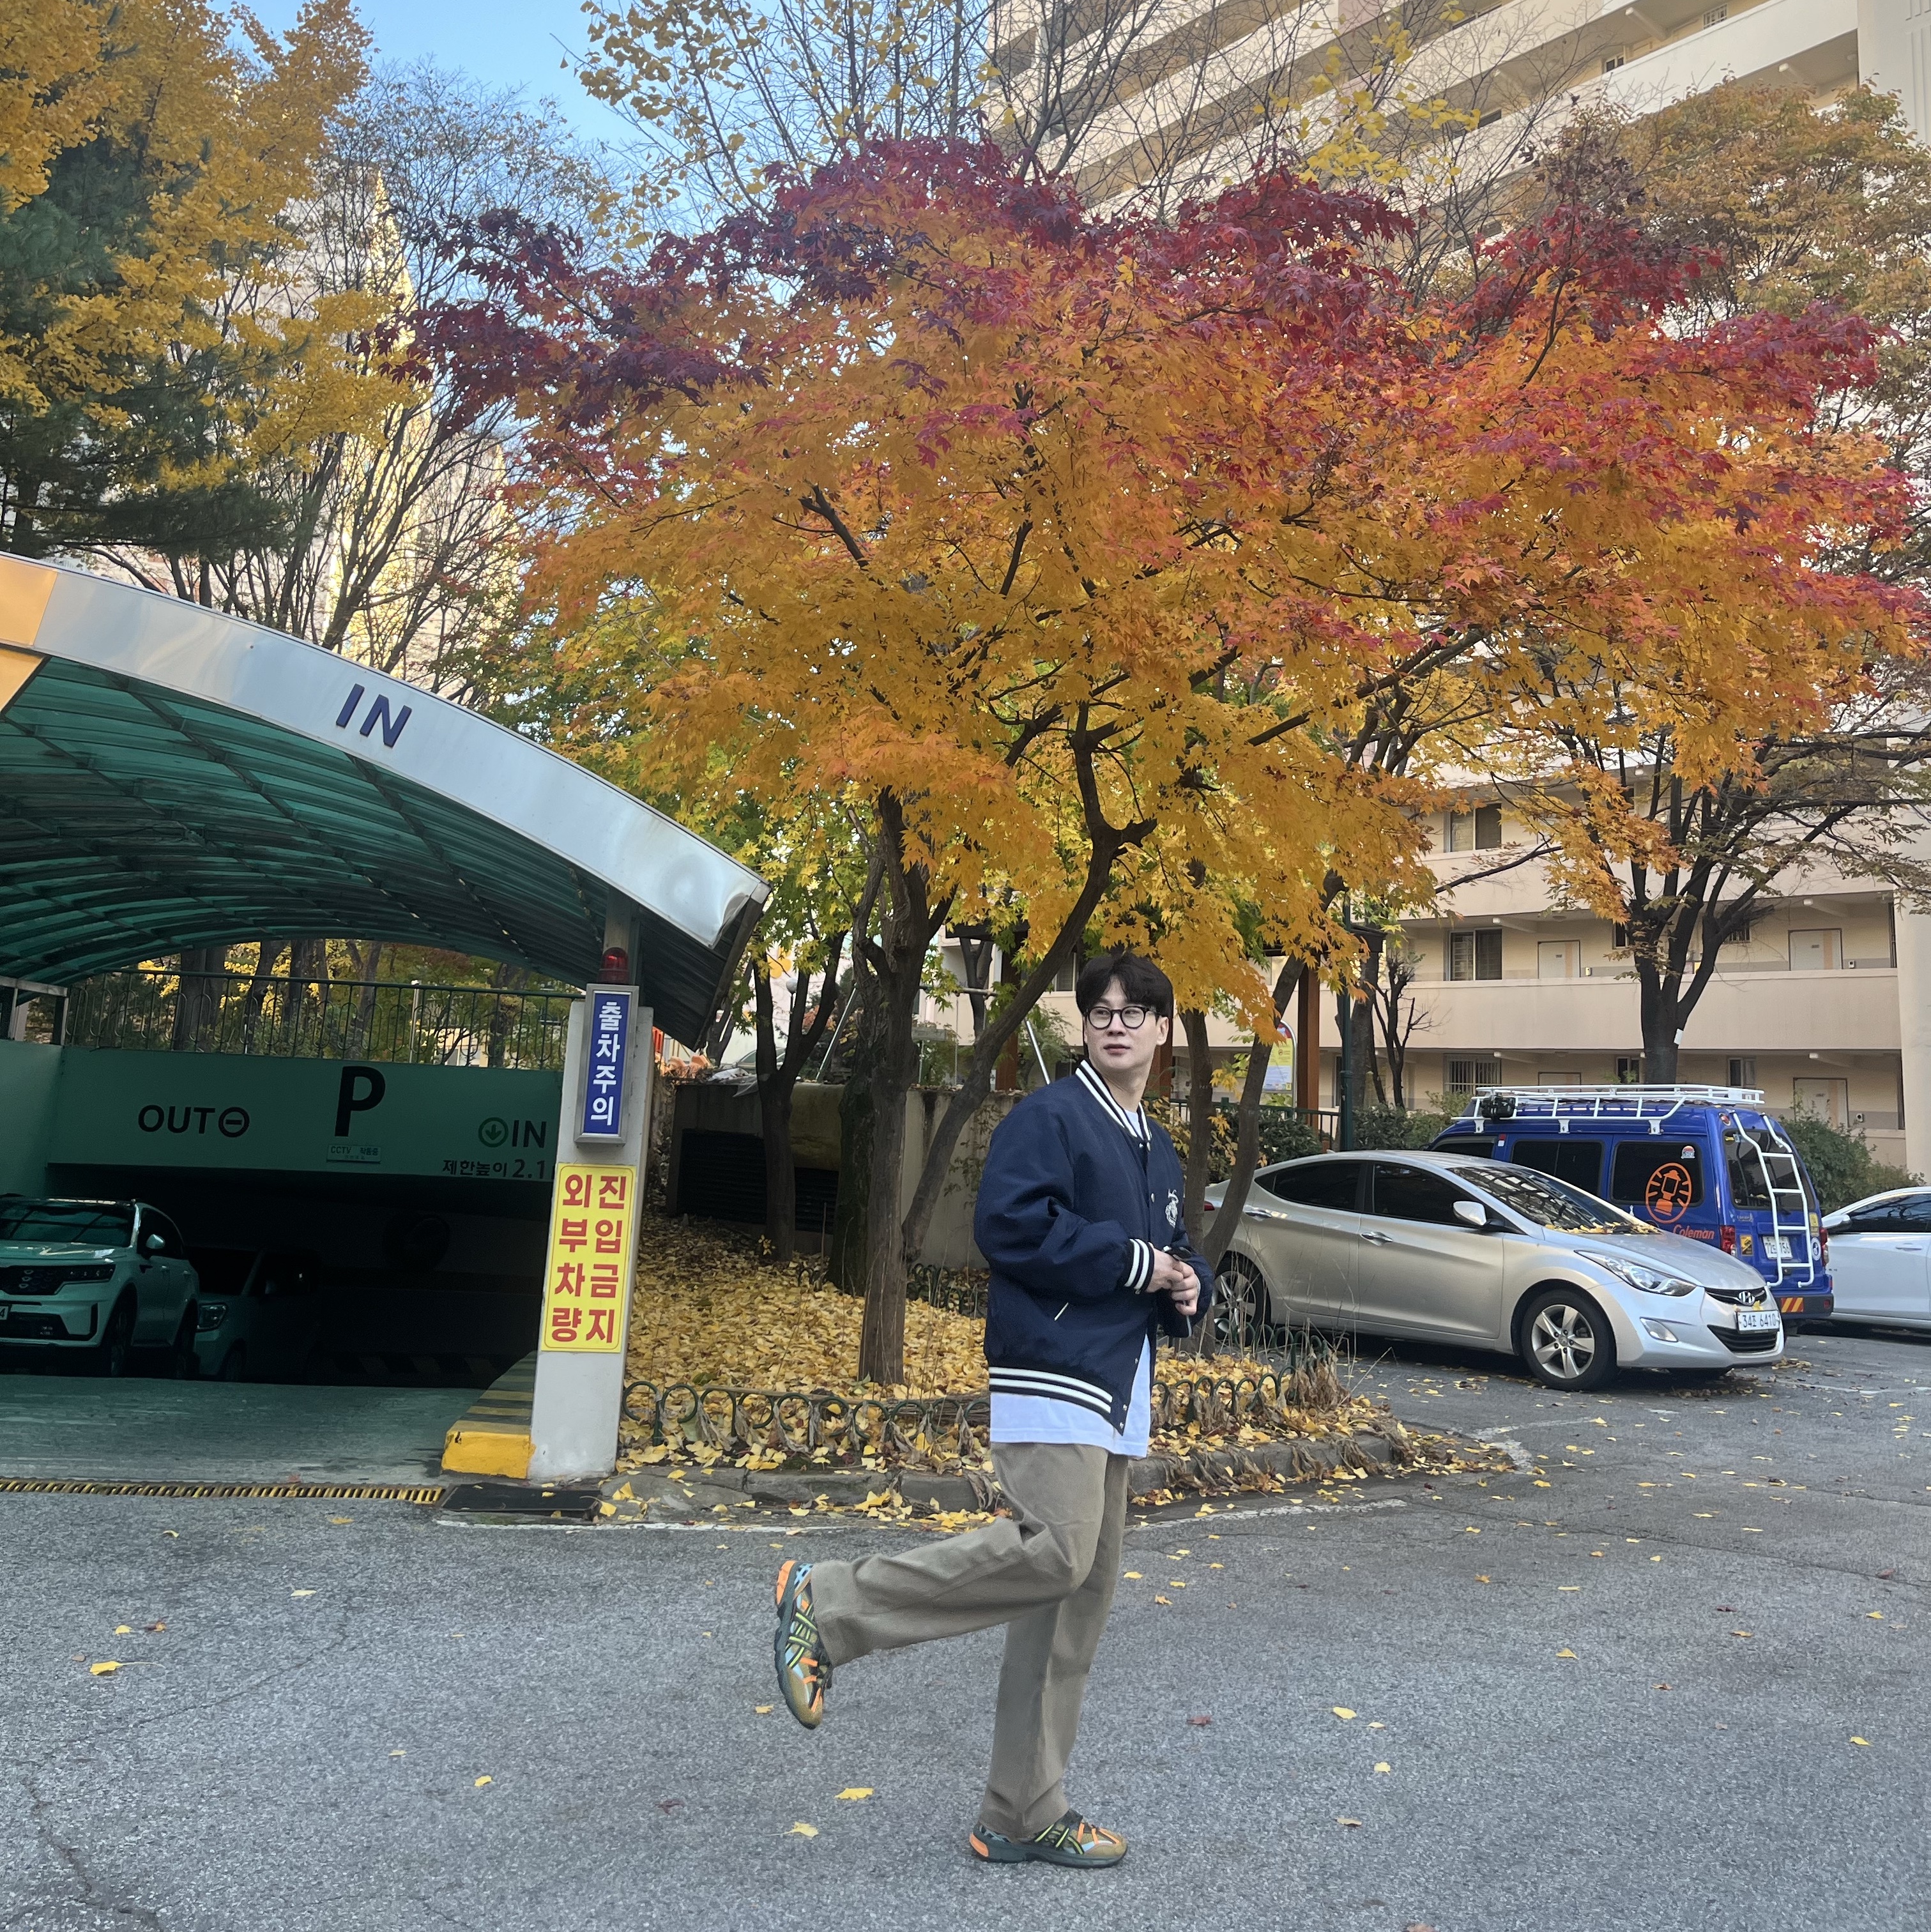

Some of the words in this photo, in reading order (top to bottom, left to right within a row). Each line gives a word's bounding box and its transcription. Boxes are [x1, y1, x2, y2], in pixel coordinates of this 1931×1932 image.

[336, 683, 412, 748] IN
[590, 1001, 622, 1126] 출차주의
[334, 1066, 386, 1137] P
[138, 1104, 215, 1134] OUT
[512, 1120, 547, 1148] IN
[330, 1146, 352, 1154] CCTV
[442, 1159, 508, 1178] 제한높이
[512, 1159, 554, 1180] 2.1
[1673, 1224, 1715, 1240] Coleman
[551, 1174, 593, 1343] 외부차량
[586, 1175, 627, 1344] 진입금지
[1760, 1313, 1776, 1327] 6410
